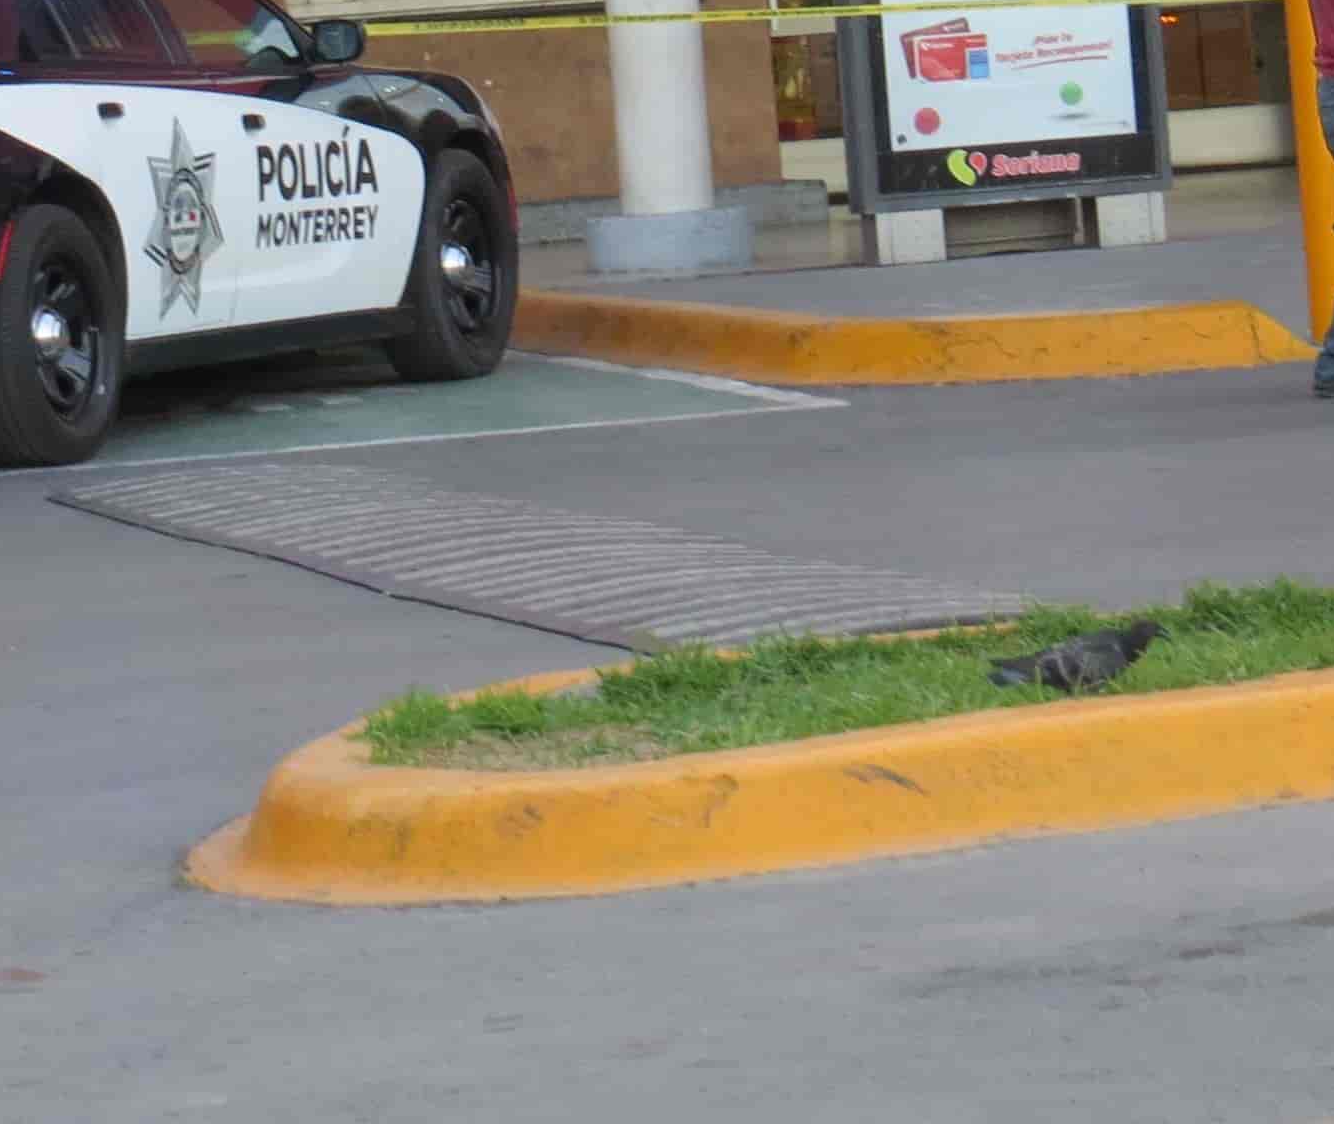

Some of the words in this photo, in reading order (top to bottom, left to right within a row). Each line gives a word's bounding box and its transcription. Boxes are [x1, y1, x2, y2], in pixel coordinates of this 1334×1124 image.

[255, 124, 379, 202] POLICÍA
[991, 149, 1081, 176] Soriana
[255, 204, 379, 249] MONTERREY
